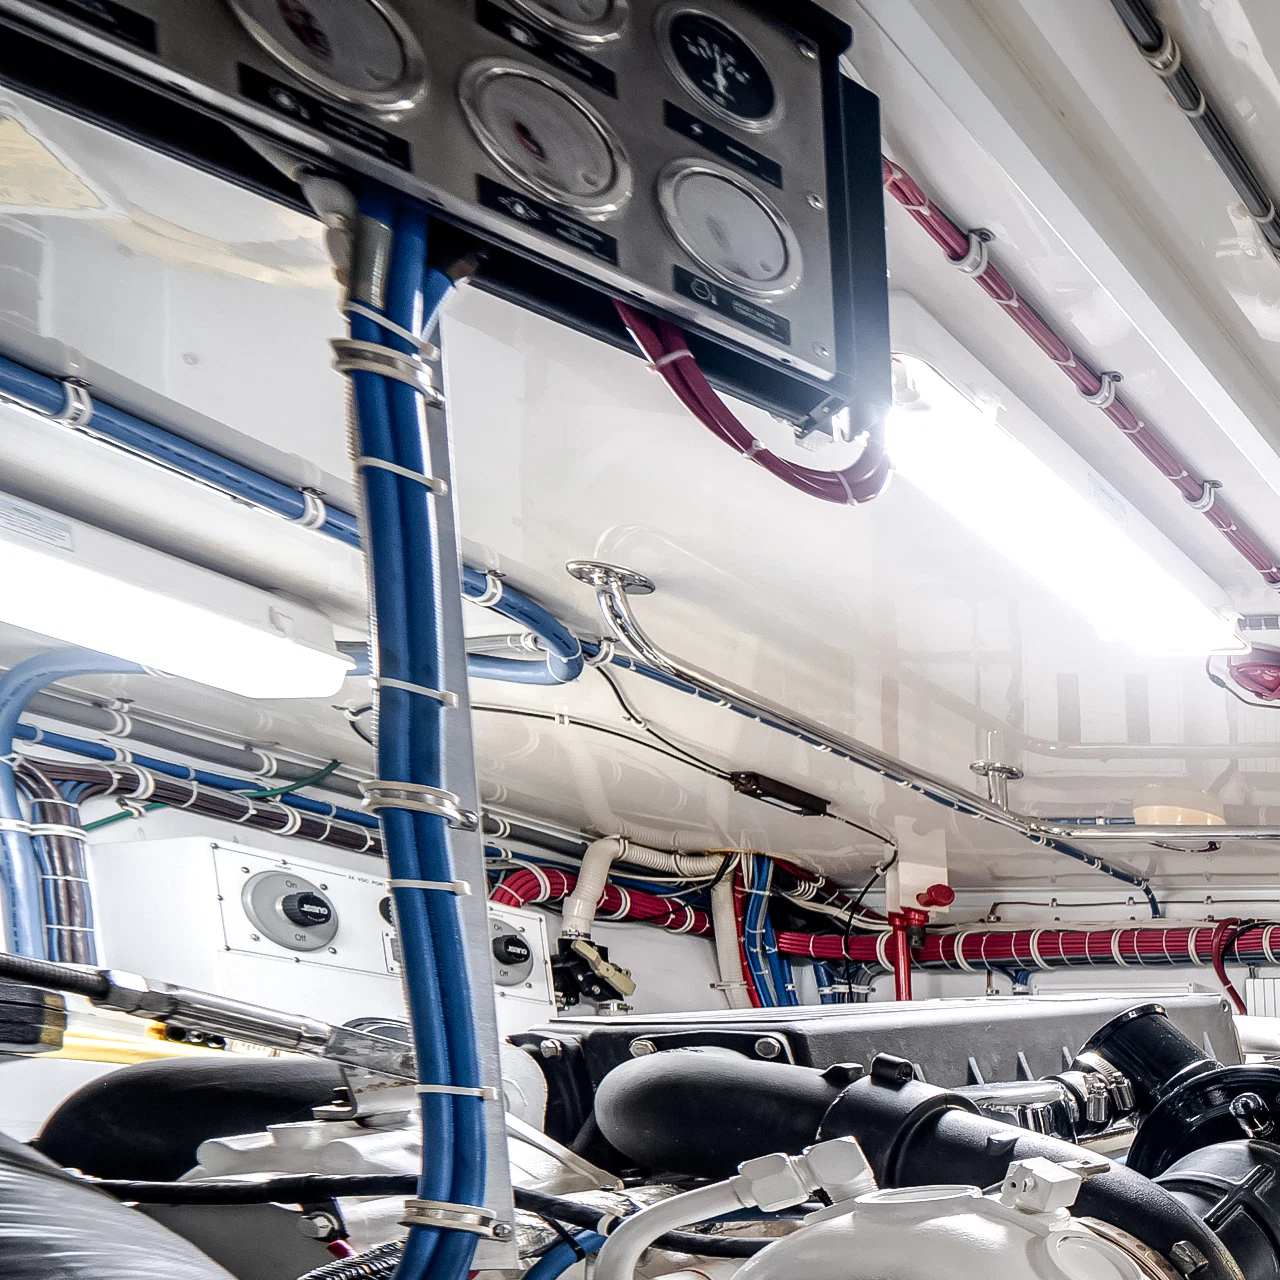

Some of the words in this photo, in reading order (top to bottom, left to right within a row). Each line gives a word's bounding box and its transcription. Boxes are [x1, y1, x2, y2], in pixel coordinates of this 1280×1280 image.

[285, 880, 298, 889] On
[493, 923, 504, 932] On
[294, 933, 307, 942] Off
[499, 969, 509, 977] Off
